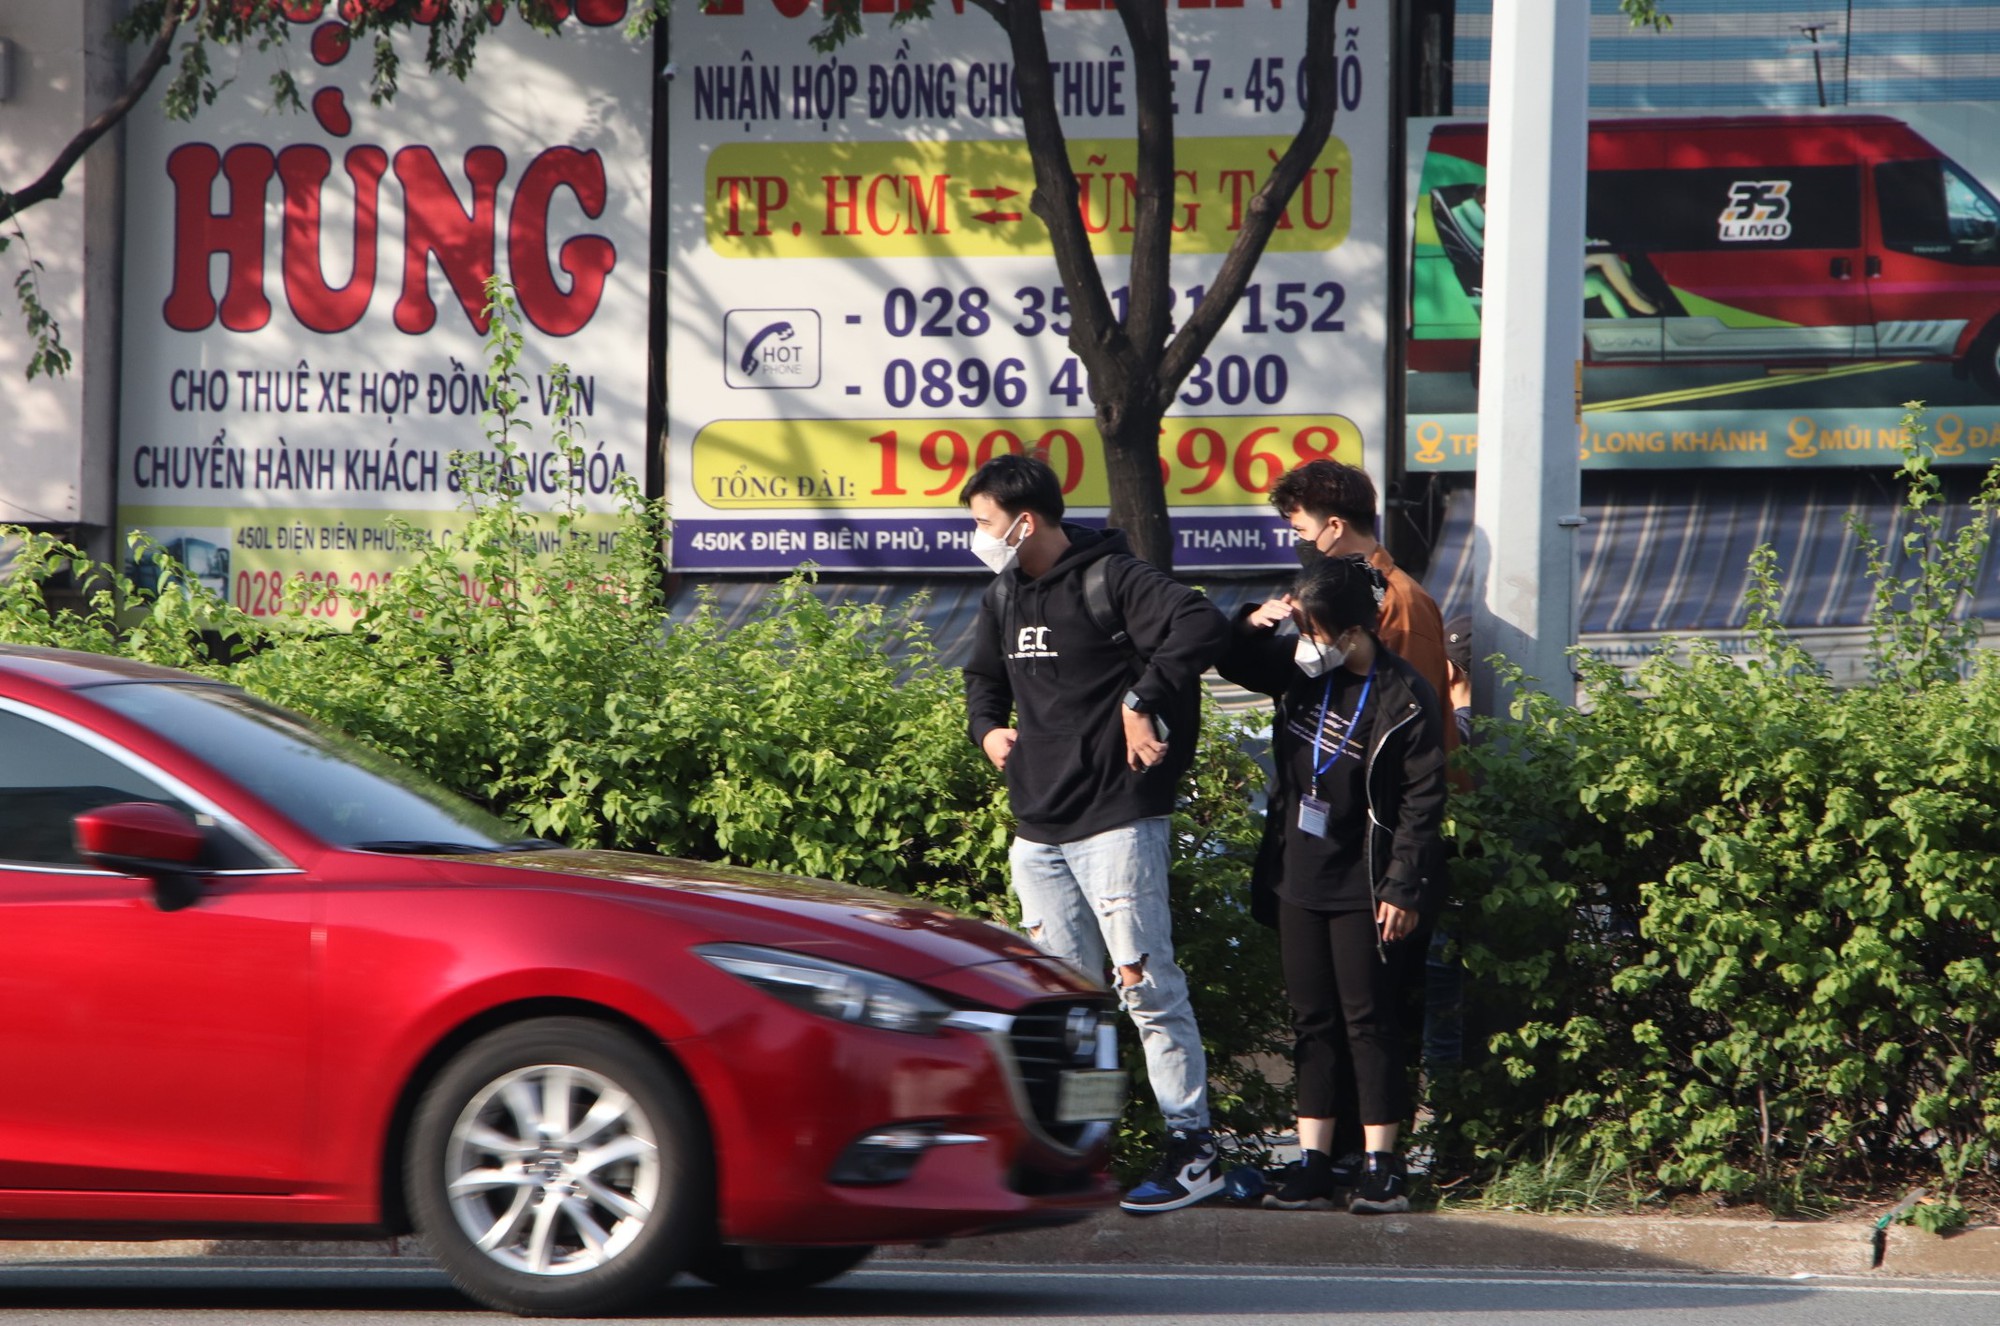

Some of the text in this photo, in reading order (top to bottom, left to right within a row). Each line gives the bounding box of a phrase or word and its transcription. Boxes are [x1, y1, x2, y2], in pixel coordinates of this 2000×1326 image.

[694, 50, 780, 132] NHẬN
[793, 56, 858, 132] HỢP
[868, 38, 956, 120] ĐỒNG
[1193, 59, 1211, 114] 7
[1245, 57, 1284, 113] 45
[163, 86, 617, 337] HÙNG
[716, 176, 802, 236] TP.
[820, 173, 952, 236] HCM
[1722, 223, 1788, 238] LIMO
[884, 286, 991, 337] 028
[1241, 282, 1346, 333] 152
[763, 346, 803, 363] HOT
[763, 364, 803, 375] PHONE
[883, 357, 1028, 408] 0896
[1179, 354, 1288, 406] 300
[170, 369, 229, 413] CHO
[237, 359, 310, 413] THUÊ
[318, 371, 351, 413] XE
[360, 370, 419, 424] HỢP
[134, 429, 246, 489] CHUYỂN
[255, 436, 335, 490] HÀNH
[345, 438, 437, 492] KHÁCH
[711, 464, 787, 498] TỔNG
[797, 468, 856, 497] ĐÀI:
[1158, 426, 1340, 494] 968
[1592, 432, 1665, 453] LONG
[1672, 427, 1768, 451] KHÁNH
[1819, 424, 1872, 450] MŨI
[237, 527, 273, 549] 450L
[277, 521, 315, 555] ĐIỆN
[320, 521, 357, 550] BIÊN
[691, 532, 746, 551] 450K
[752, 528, 807, 554] ĐIỆN
[813, 527, 868, 550] BIÊN
[876, 526, 930, 552] PHỦ,
[1179, 529, 1266, 552] THẠNH,
[237, 570, 282, 617] 028
